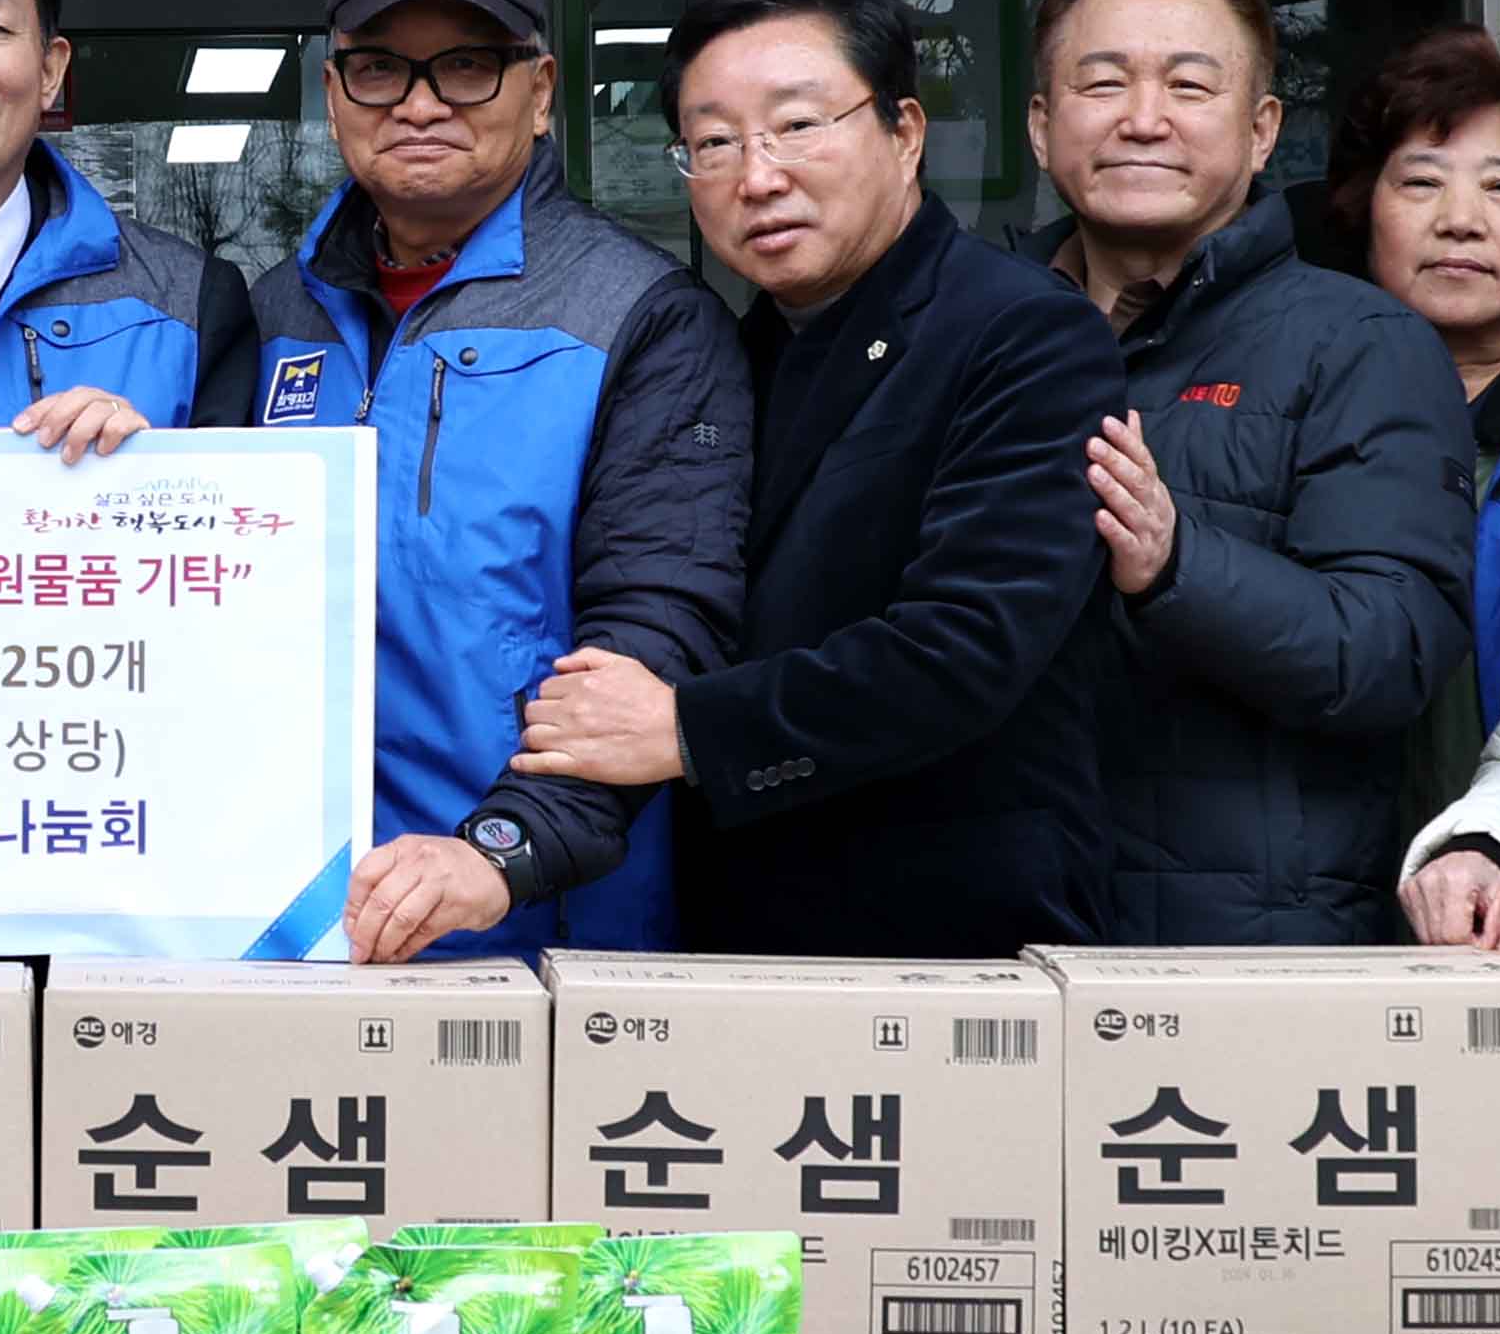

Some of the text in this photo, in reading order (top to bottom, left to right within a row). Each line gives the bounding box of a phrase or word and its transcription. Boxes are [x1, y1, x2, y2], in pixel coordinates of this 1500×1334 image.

[93, 492, 131, 507] 살고
[20, 506, 296, 536] 활기찬 행복도시 동구
[0, 639, 149, 694] 250개
[4, 720, 128, 779] 상당)
[111, 1019, 158, 1048] 애경
[623, 1014, 671, 1044] 애경
[1133, 1010, 1182, 1040] 애경
[1099, 1223, 1346, 1264] 베이킹X피톤치드
[905, 1252, 1000, 1284] 6102457
